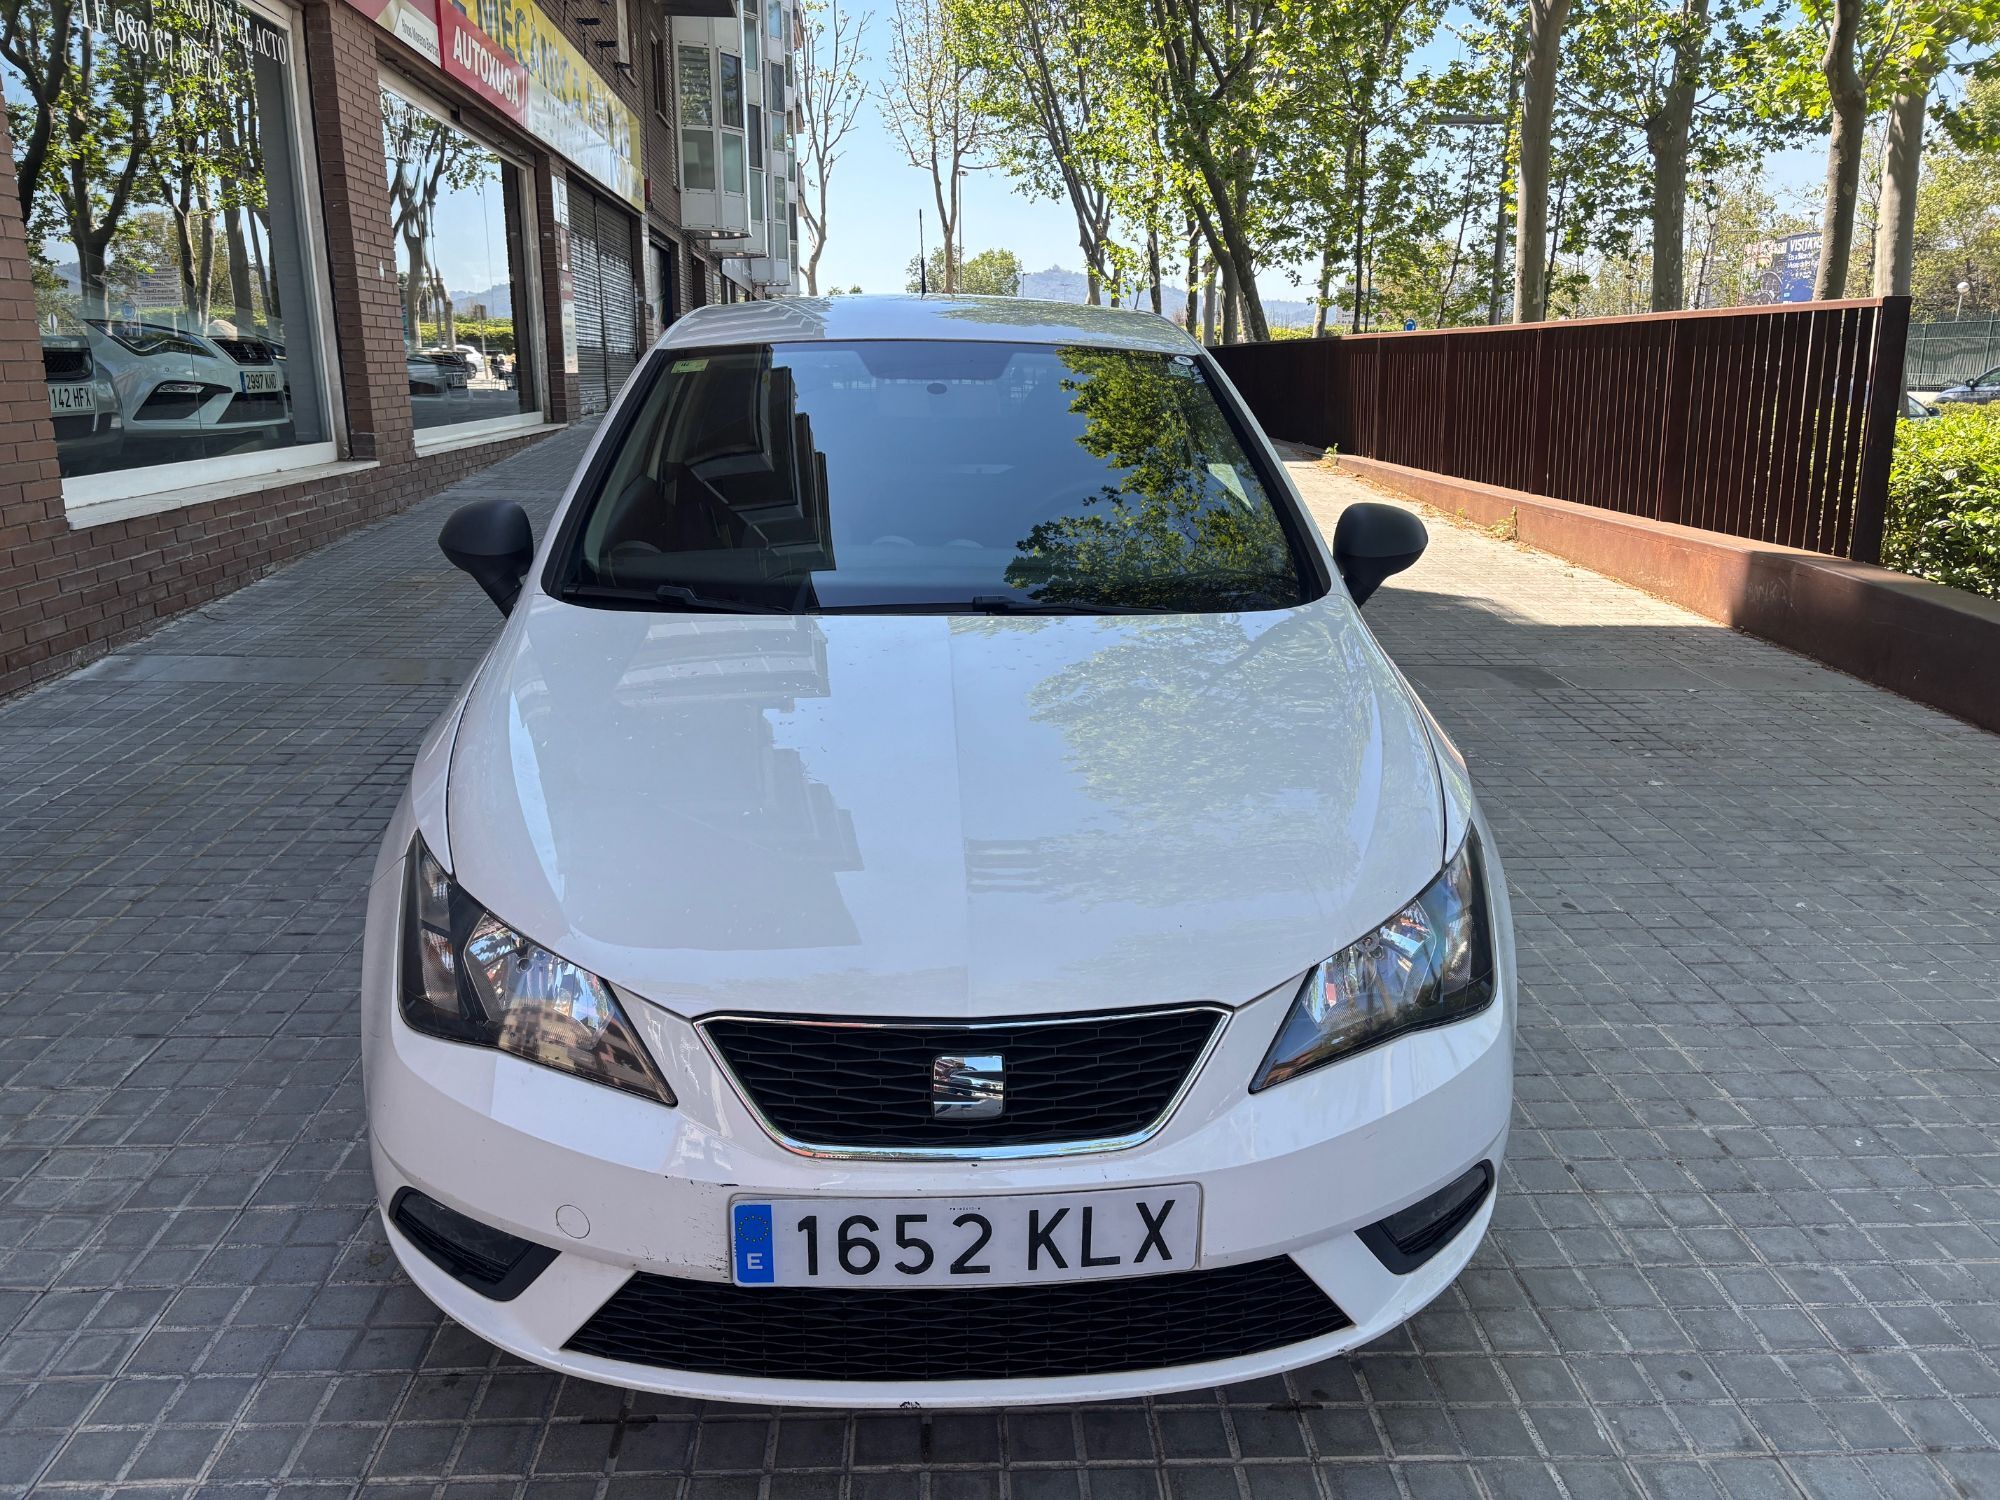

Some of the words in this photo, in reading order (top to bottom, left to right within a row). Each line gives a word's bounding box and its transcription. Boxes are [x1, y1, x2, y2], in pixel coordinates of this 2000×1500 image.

[115, 9, 149, 54] 686
[154, 28, 174, 68] 67
[213, 0, 233, 37] EN
[234, 12, 253, 52] EL
[256, 23, 287, 65] ACTO
[453, 25, 519, 109] AUTOXUGA
[48, 388, 72, 408] 142
[72, 387, 92, 407] HFX
[246, 374, 264, 390] 2997
[746, 1252, 764, 1270] E
[797, 1213, 993, 1276] 1652
[1027, 1199, 1176, 1271] KLX
